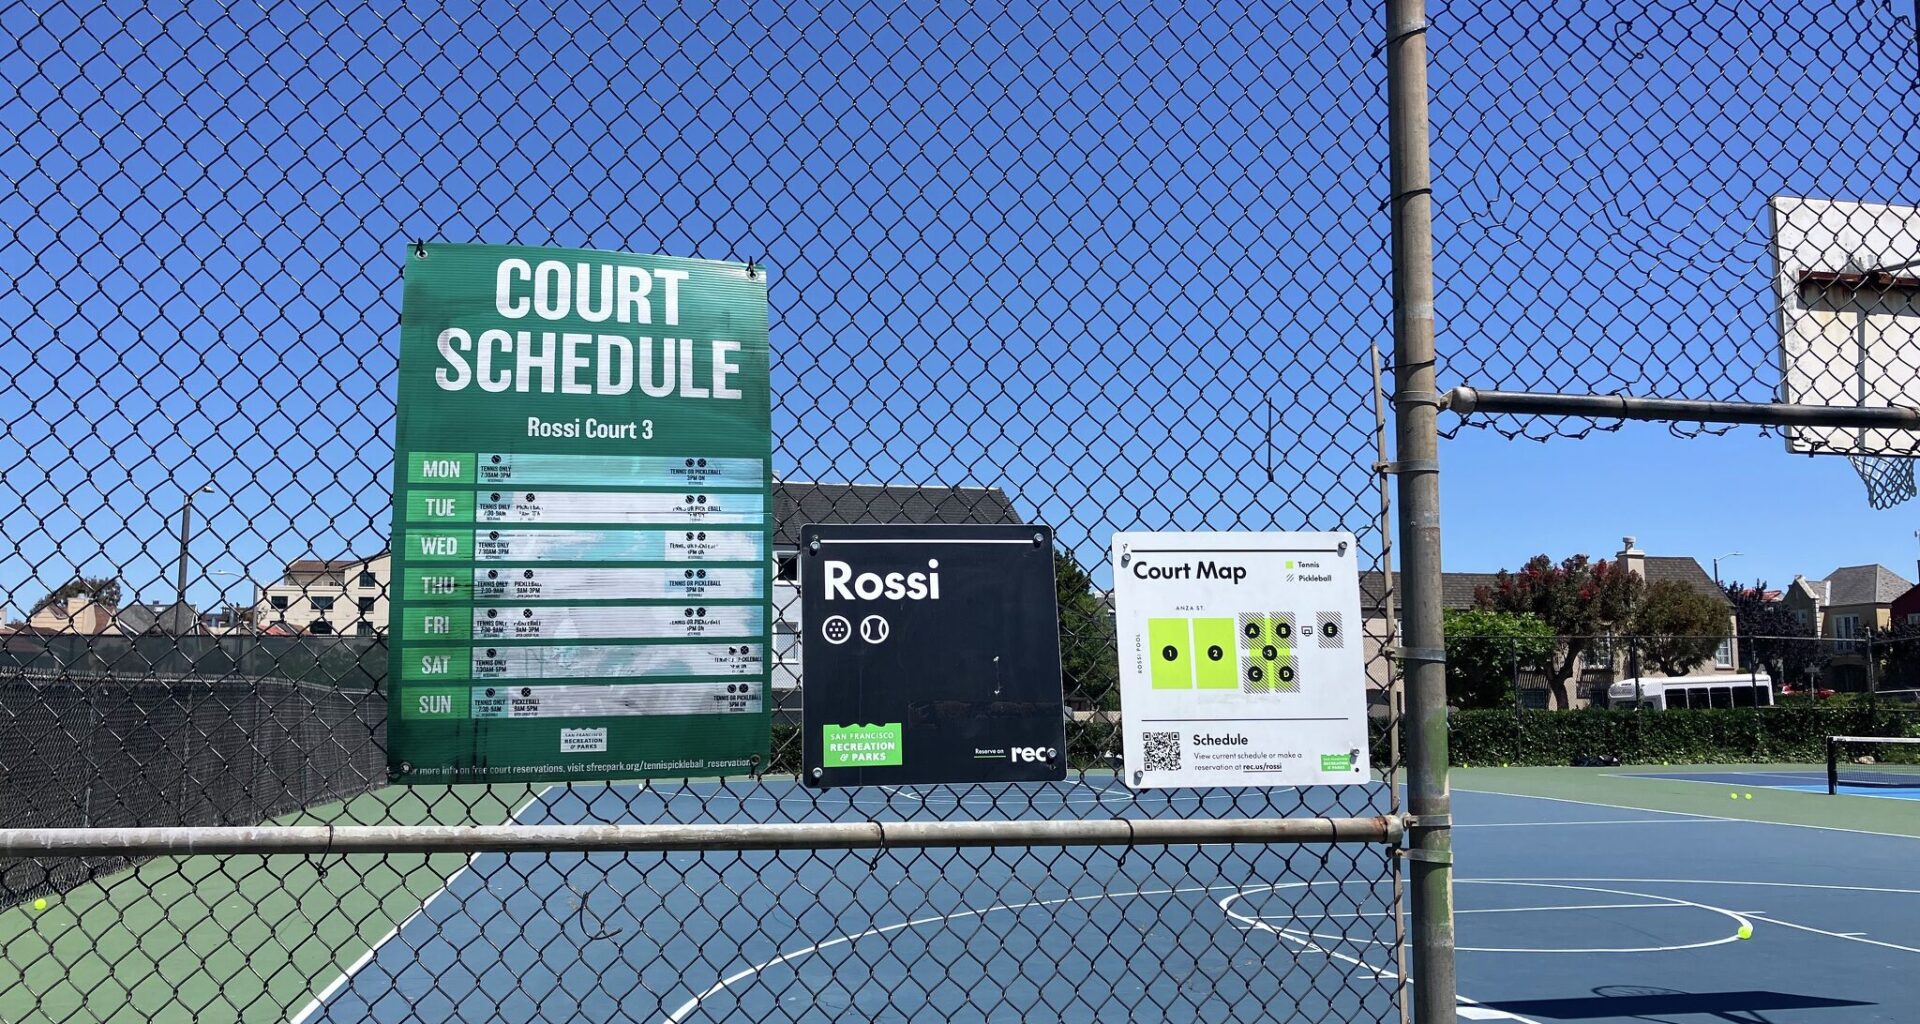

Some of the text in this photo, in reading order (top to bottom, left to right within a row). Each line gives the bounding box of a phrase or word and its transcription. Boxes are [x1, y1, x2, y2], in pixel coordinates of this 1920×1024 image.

[496, 258, 689, 326] COURT
[435, 327, 742, 399] SCHEDULE
[528, 417, 653, 440] Rossi Court 3
[423, 460, 460, 478] MON
[425, 498, 456, 517] TUE
[421, 536, 458, 555] WED
[824, 558, 940, 601] Rossi
[1133, 561, 1247, 585] Court Map
[1298, 574, 1332, 582] Pickleball
[421, 576, 455, 594] THU
[424, 616, 450, 634] FRI
[1249, 627, 1256, 635] A
[1280, 627, 1287, 635] B
[1327, 626, 1333, 634] E
[1212, 649, 1219, 657] 2
[1267, 649, 1273, 657] 3
[421, 655, 452, 674] SAT
[1252, 670, 1259, 678] C
[1283, 670, 1290, 678] D
[419, 695, 452, 714] SUN
[831, 732, 895, 741] SAN FRANCISCO
[1193, 733, 1249, 746] Schedule
[830, 742, 896, 752] RECREATION
[840, 752, 887, 762] & PARKS
[1237, 751, 1268, 759] schedule
[1277, 750, 1296, 759] make
[459, 767, 470, 775] on
[472, 765, 487, 775] free
[490, 765, 512, 774] court
[567, 762, 585, 773] visit
[1194, 763, 1233, 771] reservation
[1242, 762, 1282, 771] rec.us/rossi
